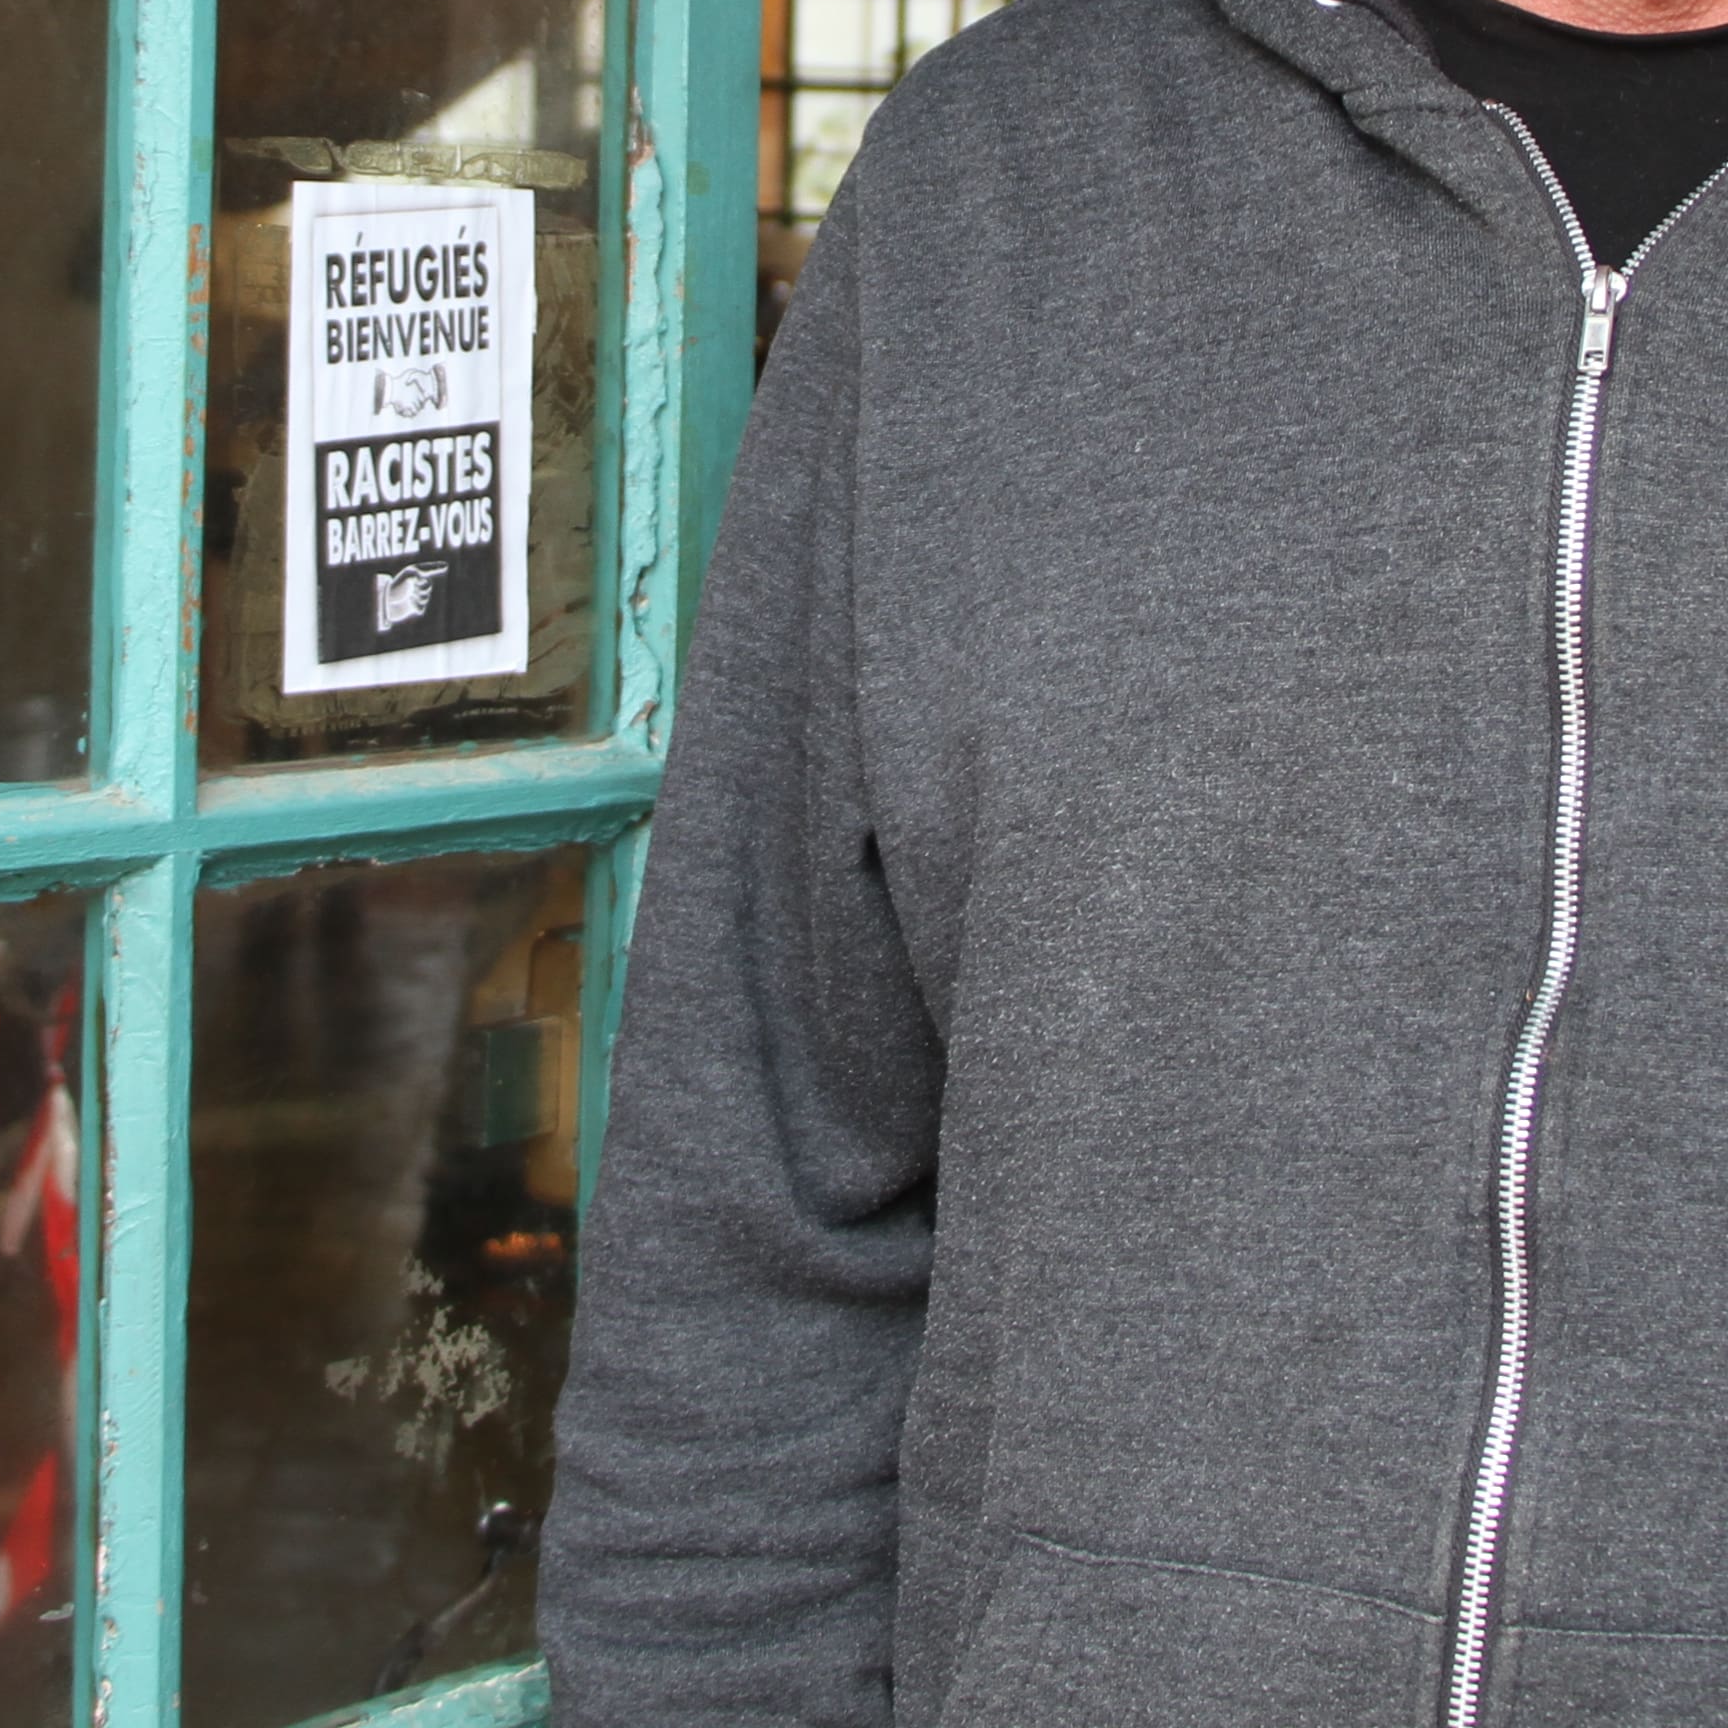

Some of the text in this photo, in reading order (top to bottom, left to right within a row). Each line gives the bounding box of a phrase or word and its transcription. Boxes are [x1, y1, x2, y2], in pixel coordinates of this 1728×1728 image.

[324, 225, 490, 309] RÉFUGIÉS
[326, 305, 490, 365] BIENVENUE
[326, 432, 493, 510] RACISTES
[326, 497, 493, 565] BARREZ-VOUS
